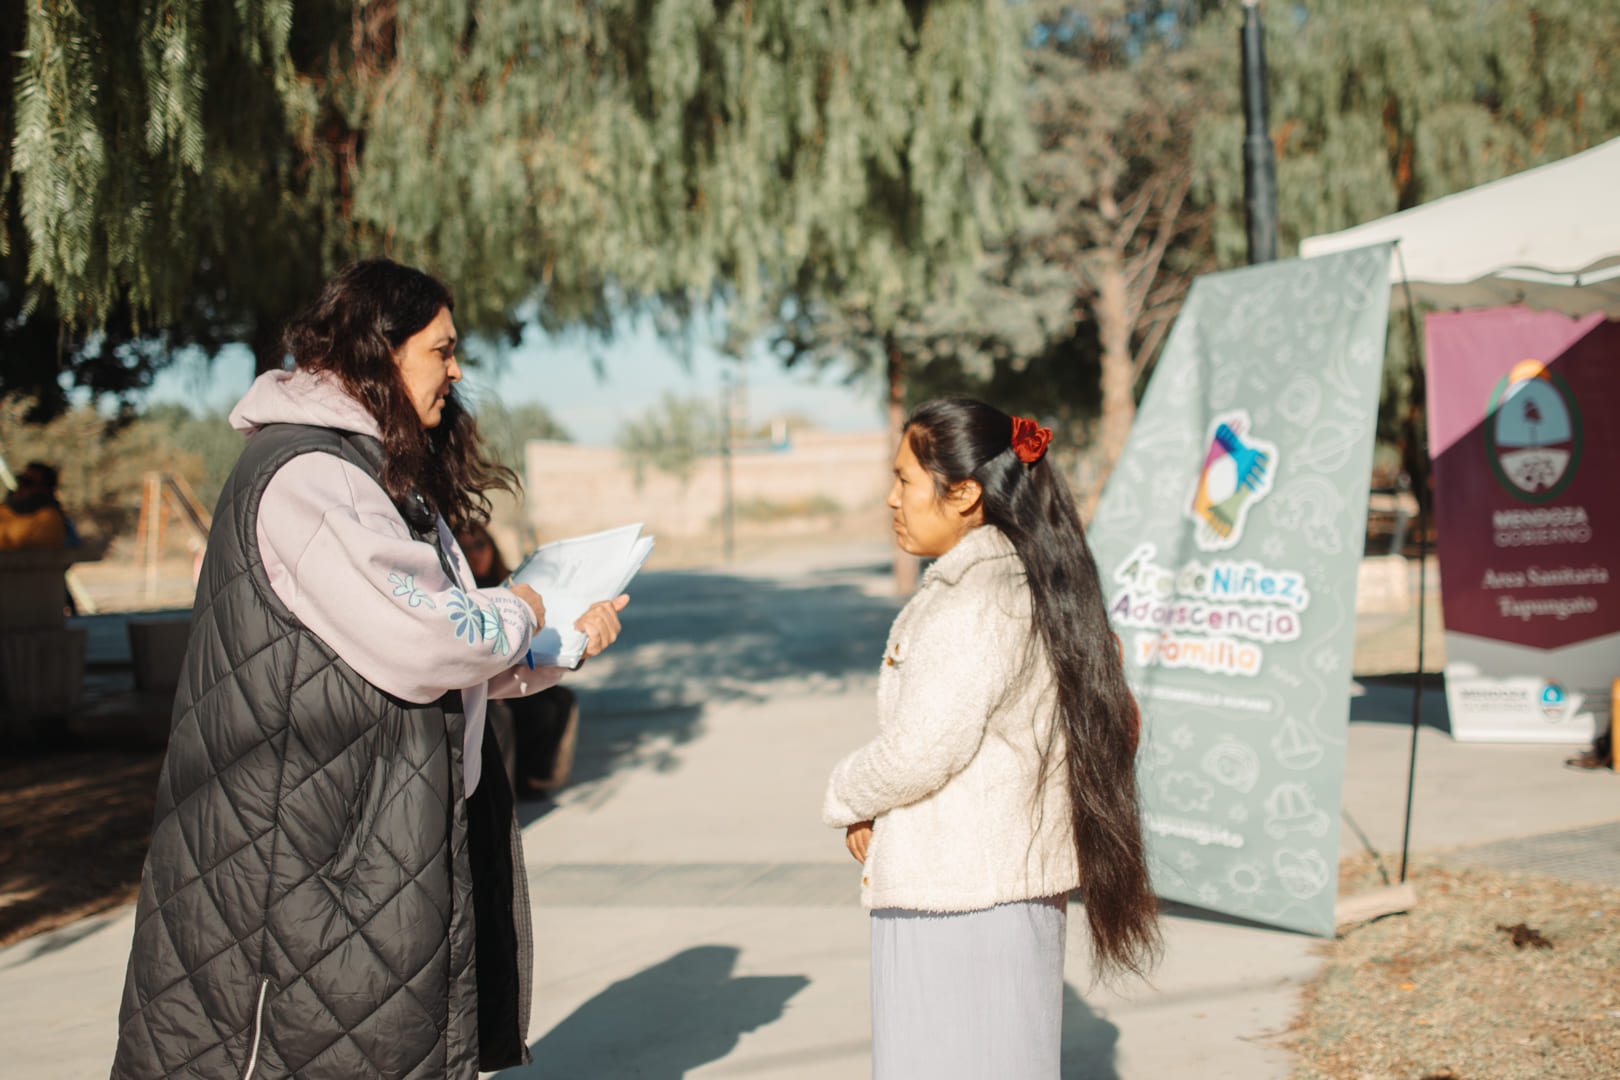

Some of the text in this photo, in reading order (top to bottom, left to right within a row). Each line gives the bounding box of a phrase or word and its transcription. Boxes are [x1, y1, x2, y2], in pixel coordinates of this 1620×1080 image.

[1493, 506, 1588, 529] MENDOZA
[1494, 524, 1592, 547] GOBIERNO
[1118, 547, 1174, 590] Áre
[1212, 566, 1306, 606] Niñez,
[1527, 565, 1609, 587] Sanitaria
[1113, 594, 1295, 637] Adoscencia
[1496, 595, 1598, 622] Tupungato
